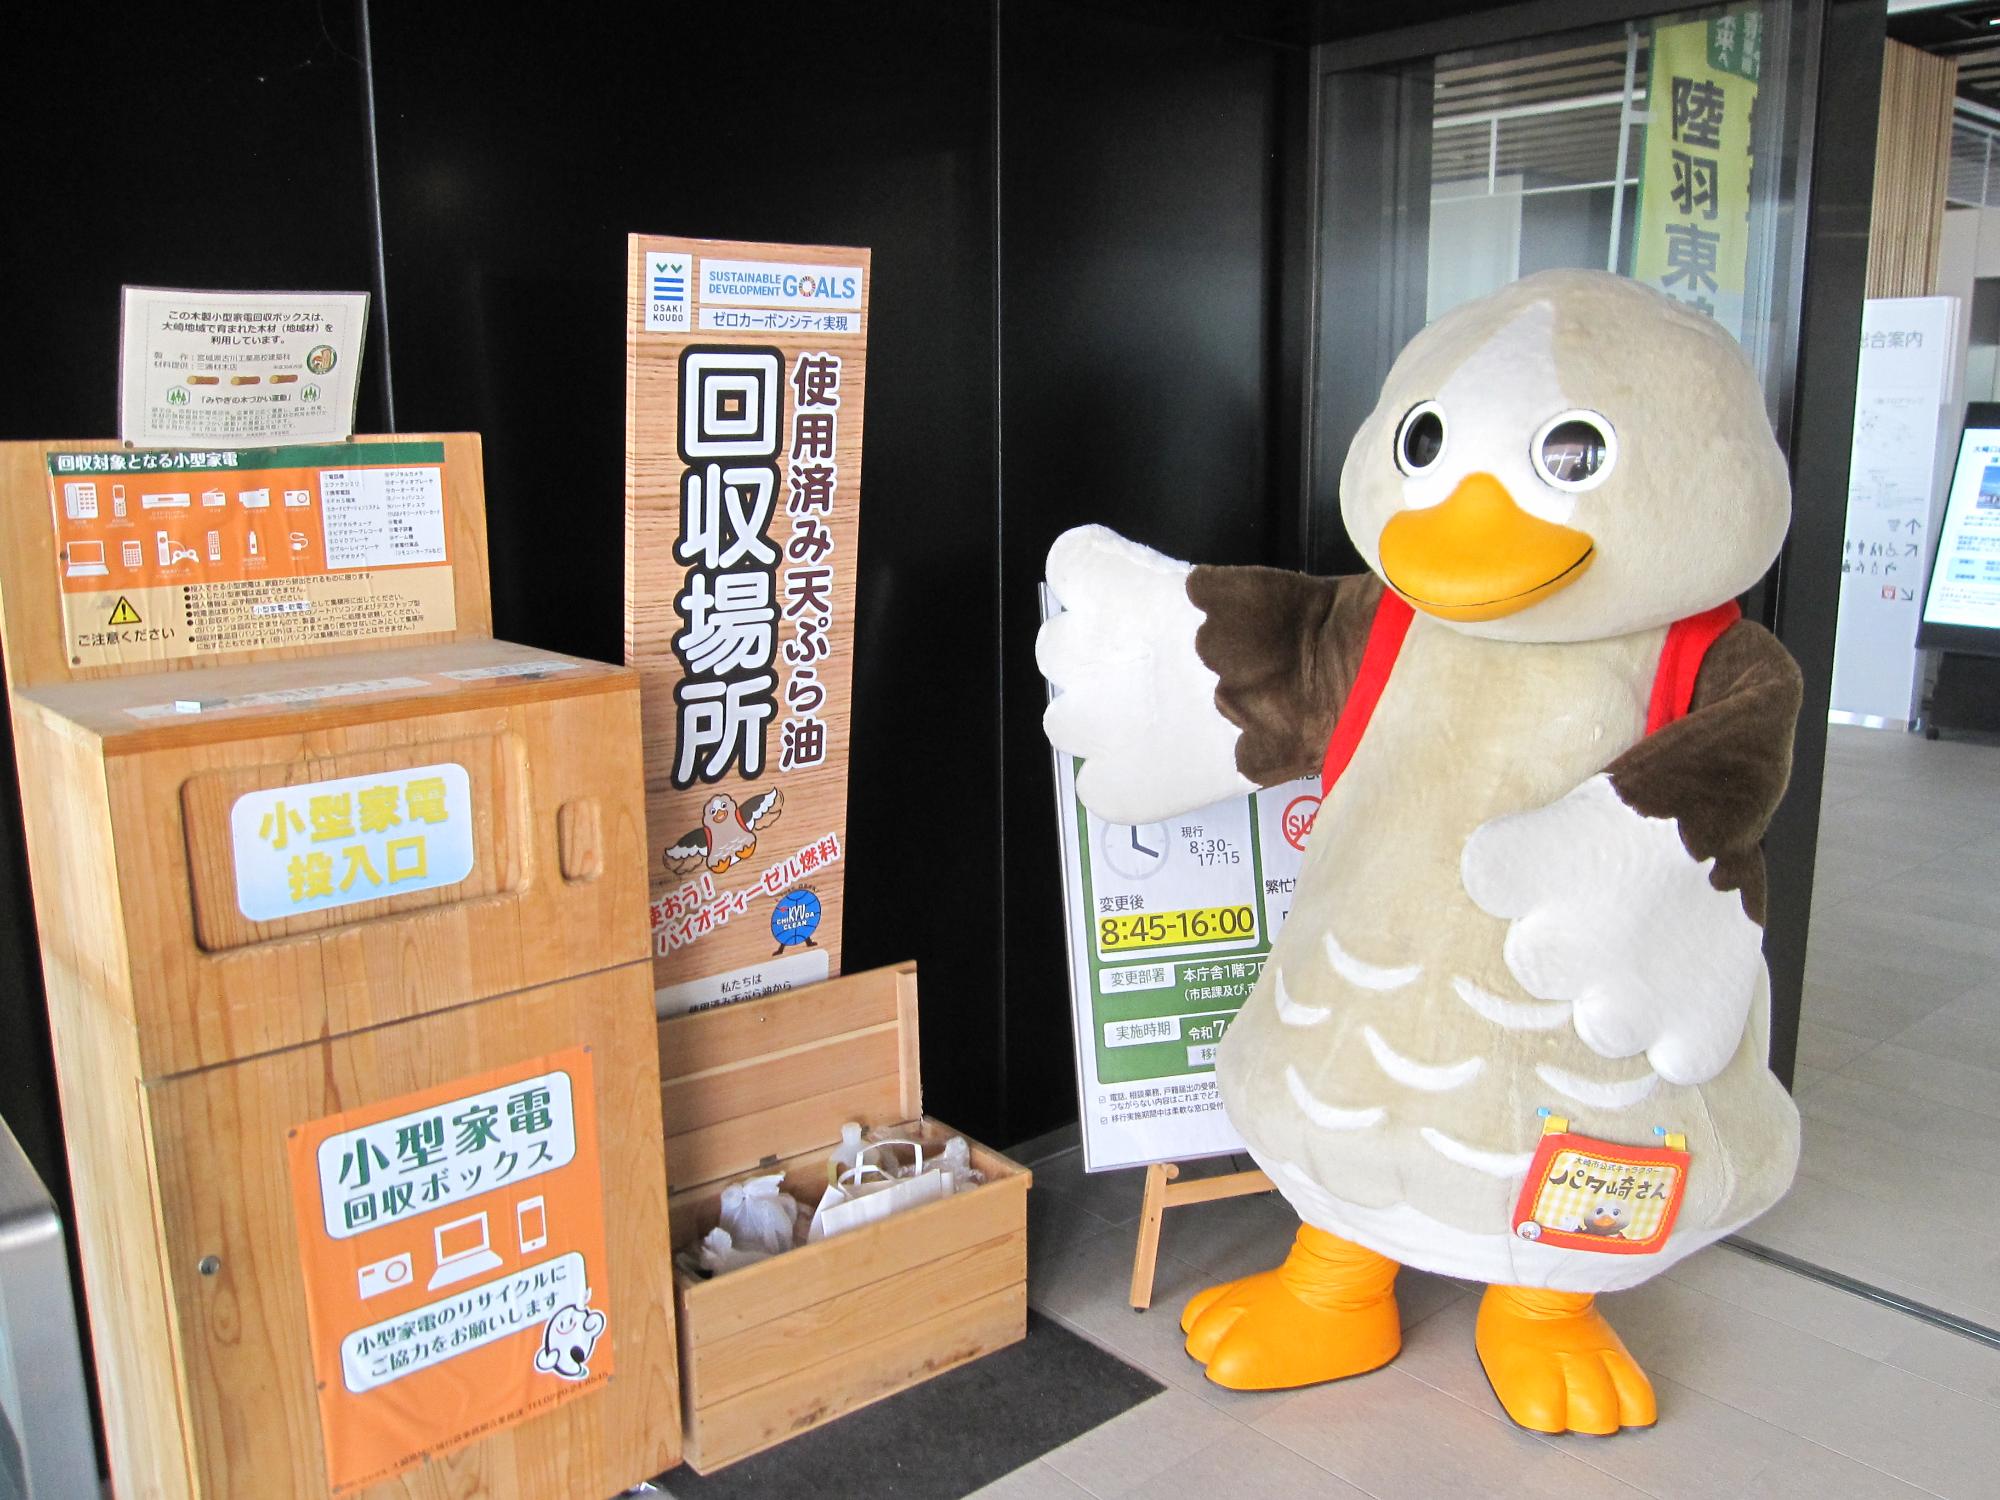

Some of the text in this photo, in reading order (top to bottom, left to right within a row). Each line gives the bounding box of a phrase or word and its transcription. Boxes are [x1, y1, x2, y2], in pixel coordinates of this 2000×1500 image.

[1661, 76, 1725, 318] 陸羽東
[709, 271, 781, 284] SUSTAINABLE
[783, 275, 855, 299] GOALS
[709, 284, 781, 296] DEVELOPMENT
[653, 304, 683, 313] OSAKI
[653, 313, 683, 322] KOUDO
[713, 311, 848, 331] ゼロカーボンシティ実現
[211, 335, 285, 345] 利用しています。
[57, 451, 239, 472] 回収対象となる小型家電
[673, 345, 785, 788] 回収場所
[782, 355, 840, 769] 使用済み天ぷら油
[77, 626, 175, 647] ご注意ください
[259, 776, 449, 850] 小型家電
[1181, 826, 1204, 839] 現行
[1189, 839, 1233, 854] 8:30-
[287, 836, 428, 902] 投入口
[1198, 851, 1240, 867] 17:15
[660, 832, 839, 953] バイオディーゼル燃料
[1265, 879, 1296, 894] 繁忙
[1100, 894, 1145, 912] 変更後
[783, 920, 808, 931] CLEAN
[1101, 906, 1255, 946] 8:45-16:00
[721, 973, 763, 994] 私たちは
[1111, 967, 1166, 987] 変更部署
[1115, 1021, 1171, 1041] 実施時期
[1188, 1019, 1230, 1041] 令和7
[1200, 1047, 1217, 1061] 移
[338, 1086, 553, 1190] 小型家電
[1574, 1157, 1662, 1175] 大崎市公式キャラクター
[343, 1140, 554, 1229] 回収ボックス
[1549, 1169, 1667, 1200] パタ崎さん
[356, 1264, 567, 1356] 小型家電のリサイクルに
[371, 1291, 559, 1377] ご協力をお願いします
